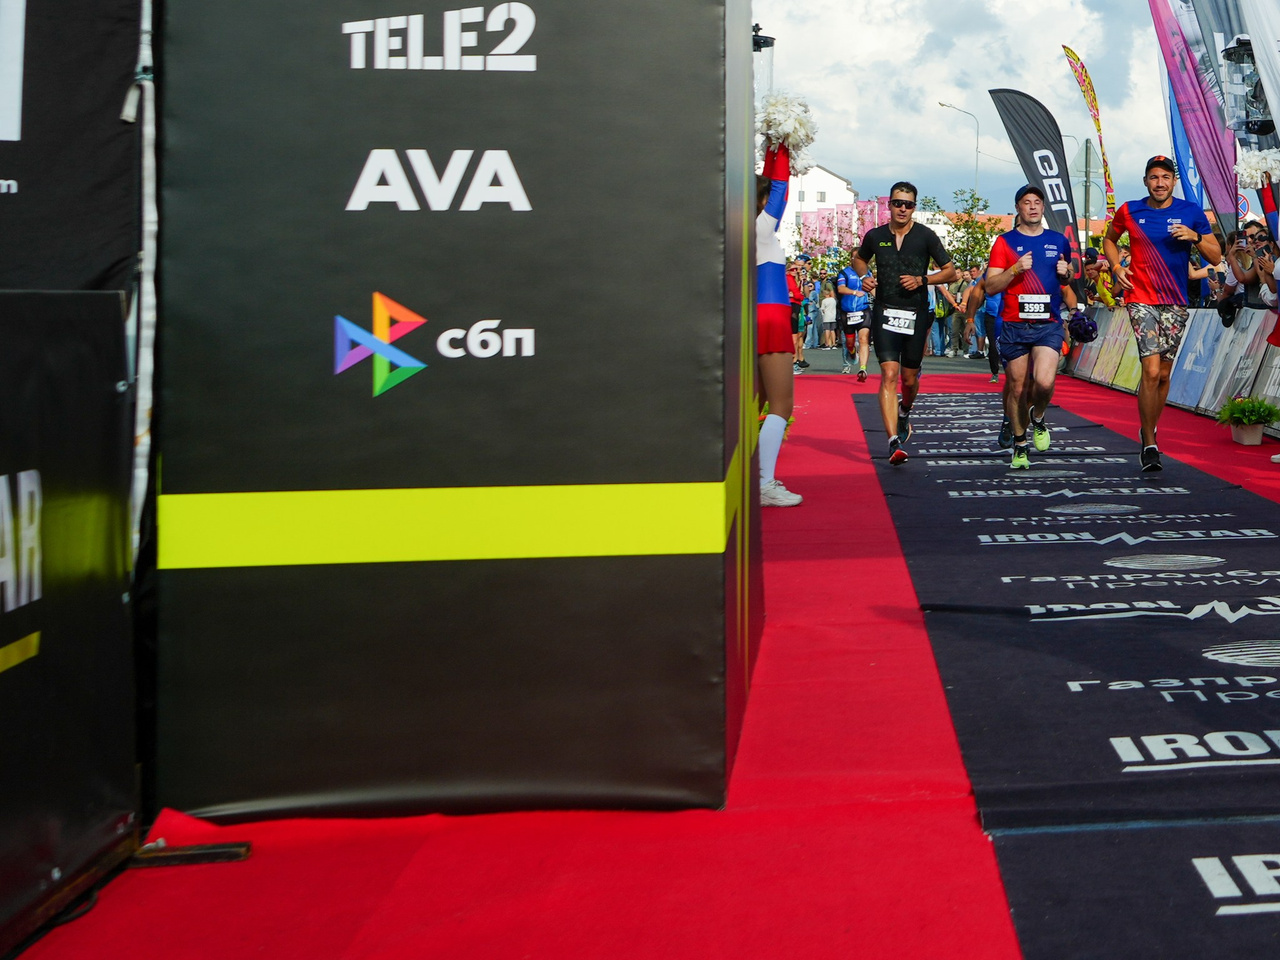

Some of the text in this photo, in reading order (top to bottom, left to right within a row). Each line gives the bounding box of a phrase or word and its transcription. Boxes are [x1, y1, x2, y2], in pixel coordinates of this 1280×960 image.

[341, 1, 538, 72] TELE2
[344, 148, 533, 212] AVA
[1023, 303, 1045, 313] 3593
[887, 317, 910, 328] 2497
[436, 319, 536, 359] сбп
[948, 487, 1190, 497] IRON STAR
[961, 512, 1237, 523] Газпромбанк
[976, 528, 1279, 544] IRON STAR
